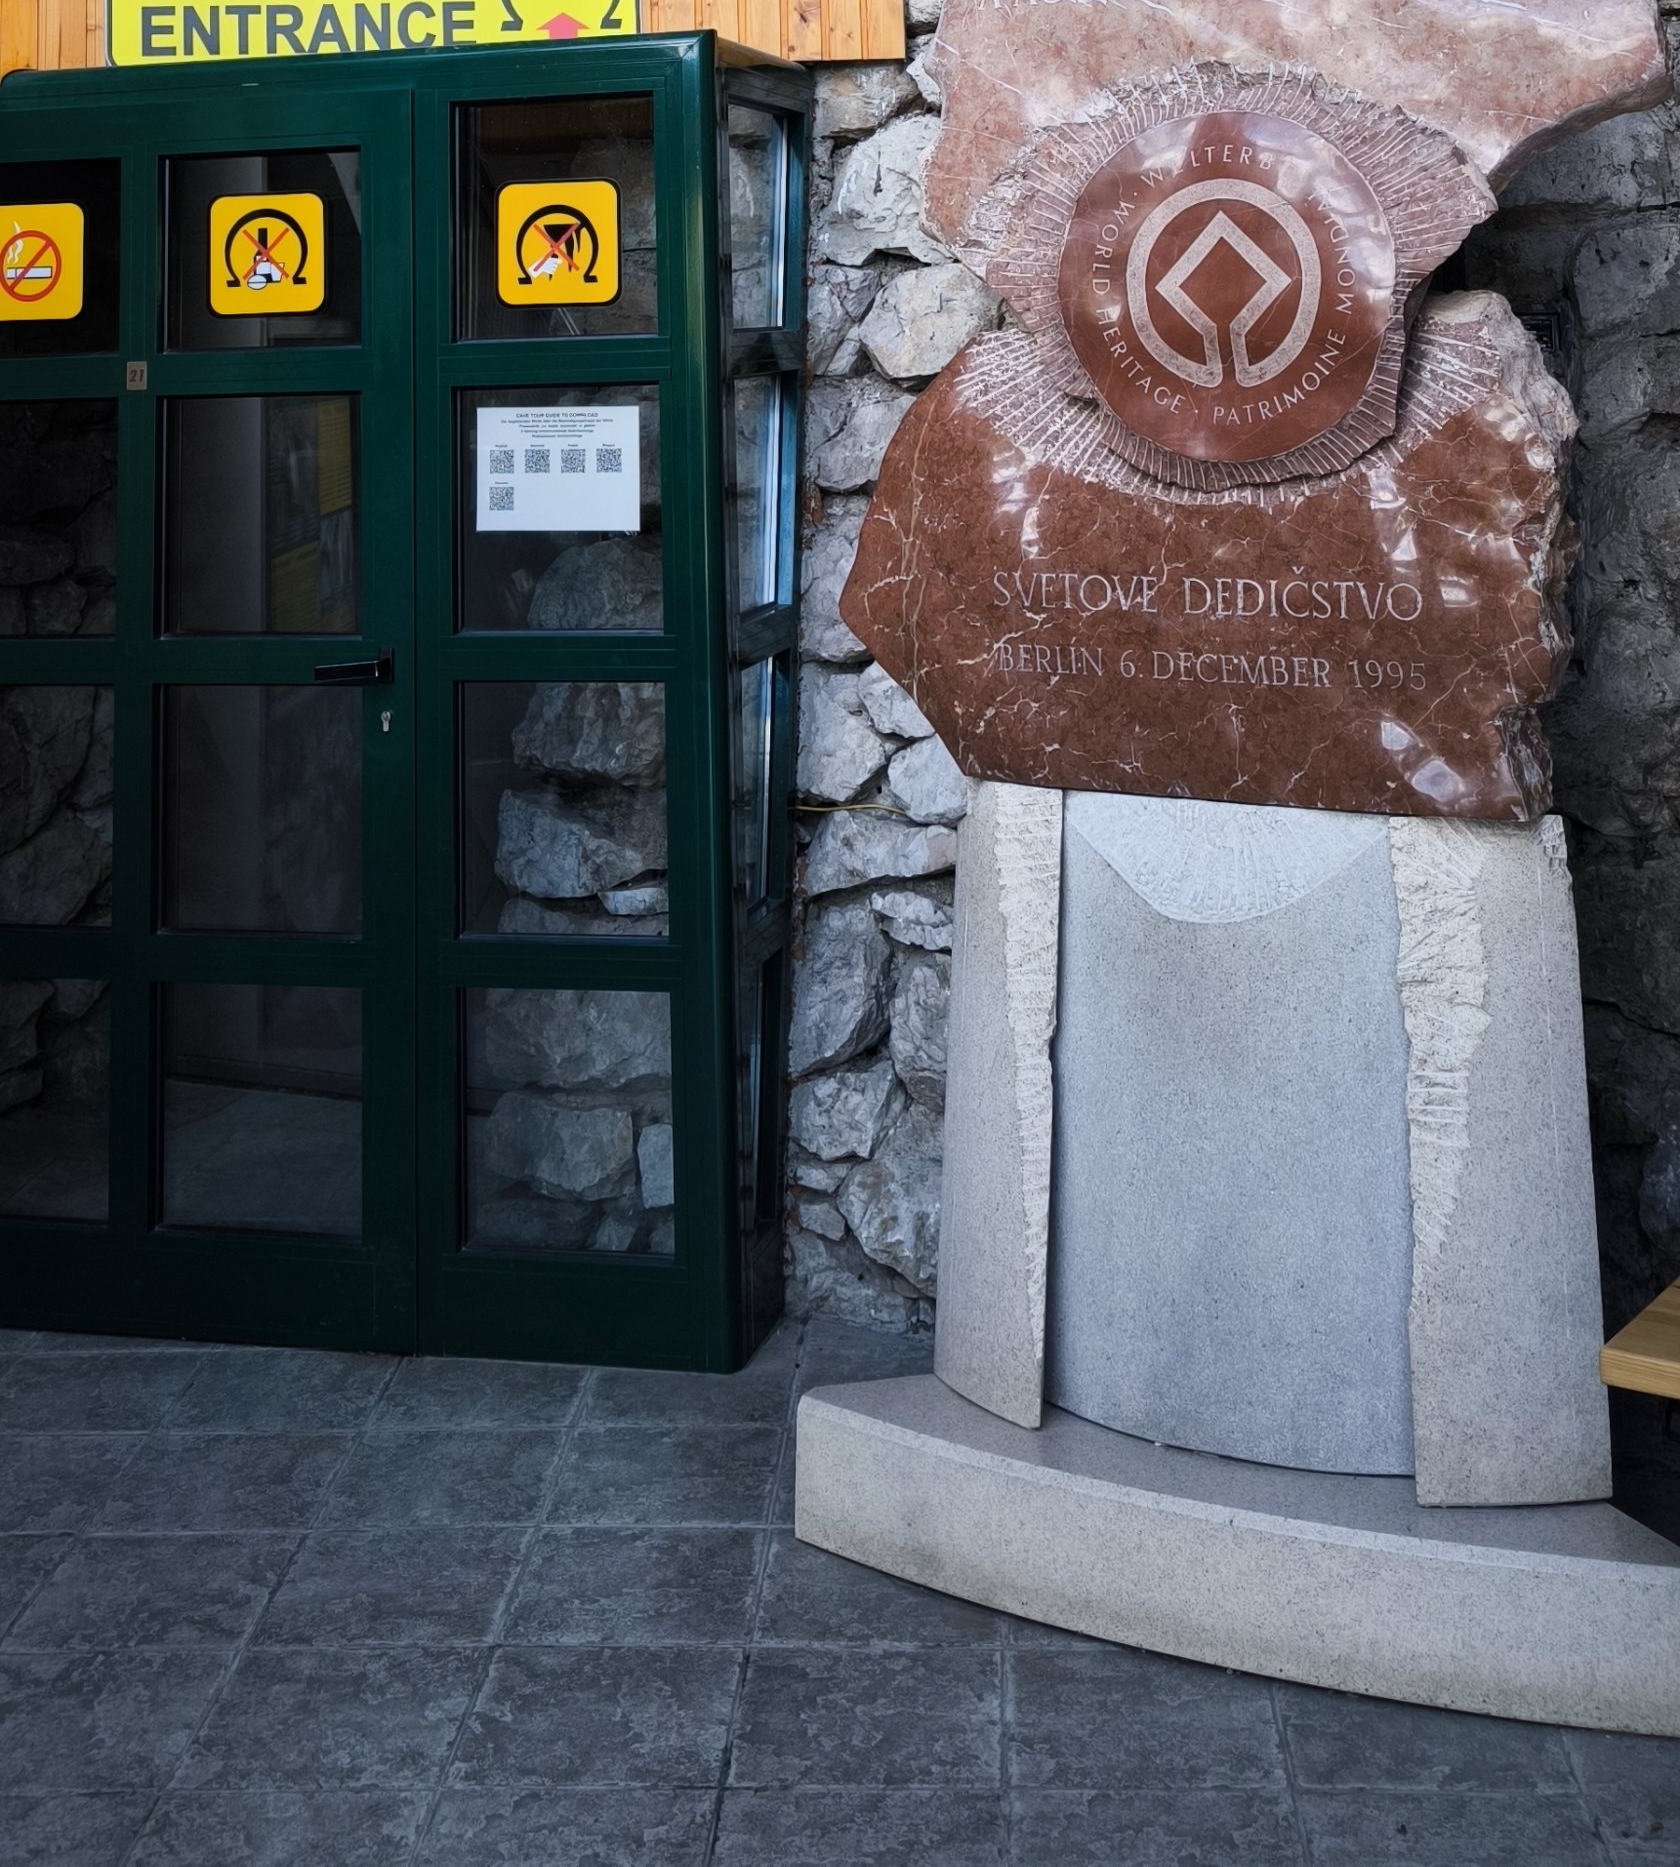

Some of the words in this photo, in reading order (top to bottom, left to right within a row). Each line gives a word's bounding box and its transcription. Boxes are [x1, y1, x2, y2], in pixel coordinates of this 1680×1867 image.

[141, 0, 477, 57] ENTRANCE
[1092, 200, 1136, 295] WORLD
[128, 368, 145, 383] 21
[1095, 309, 1187, 415] HERITAGE
[1212, 329, 1346, 426] PATRIMOINE
[993, 566, 1159, 614] SVETOVÉ
[1182, 566, 1423, 621] DEDIČSTVO
[1120, 649, 1144, 679] 6.
[1152, 650, 1332, 688] DECEMBER
[1348, 659, 1427, 691] 1995
